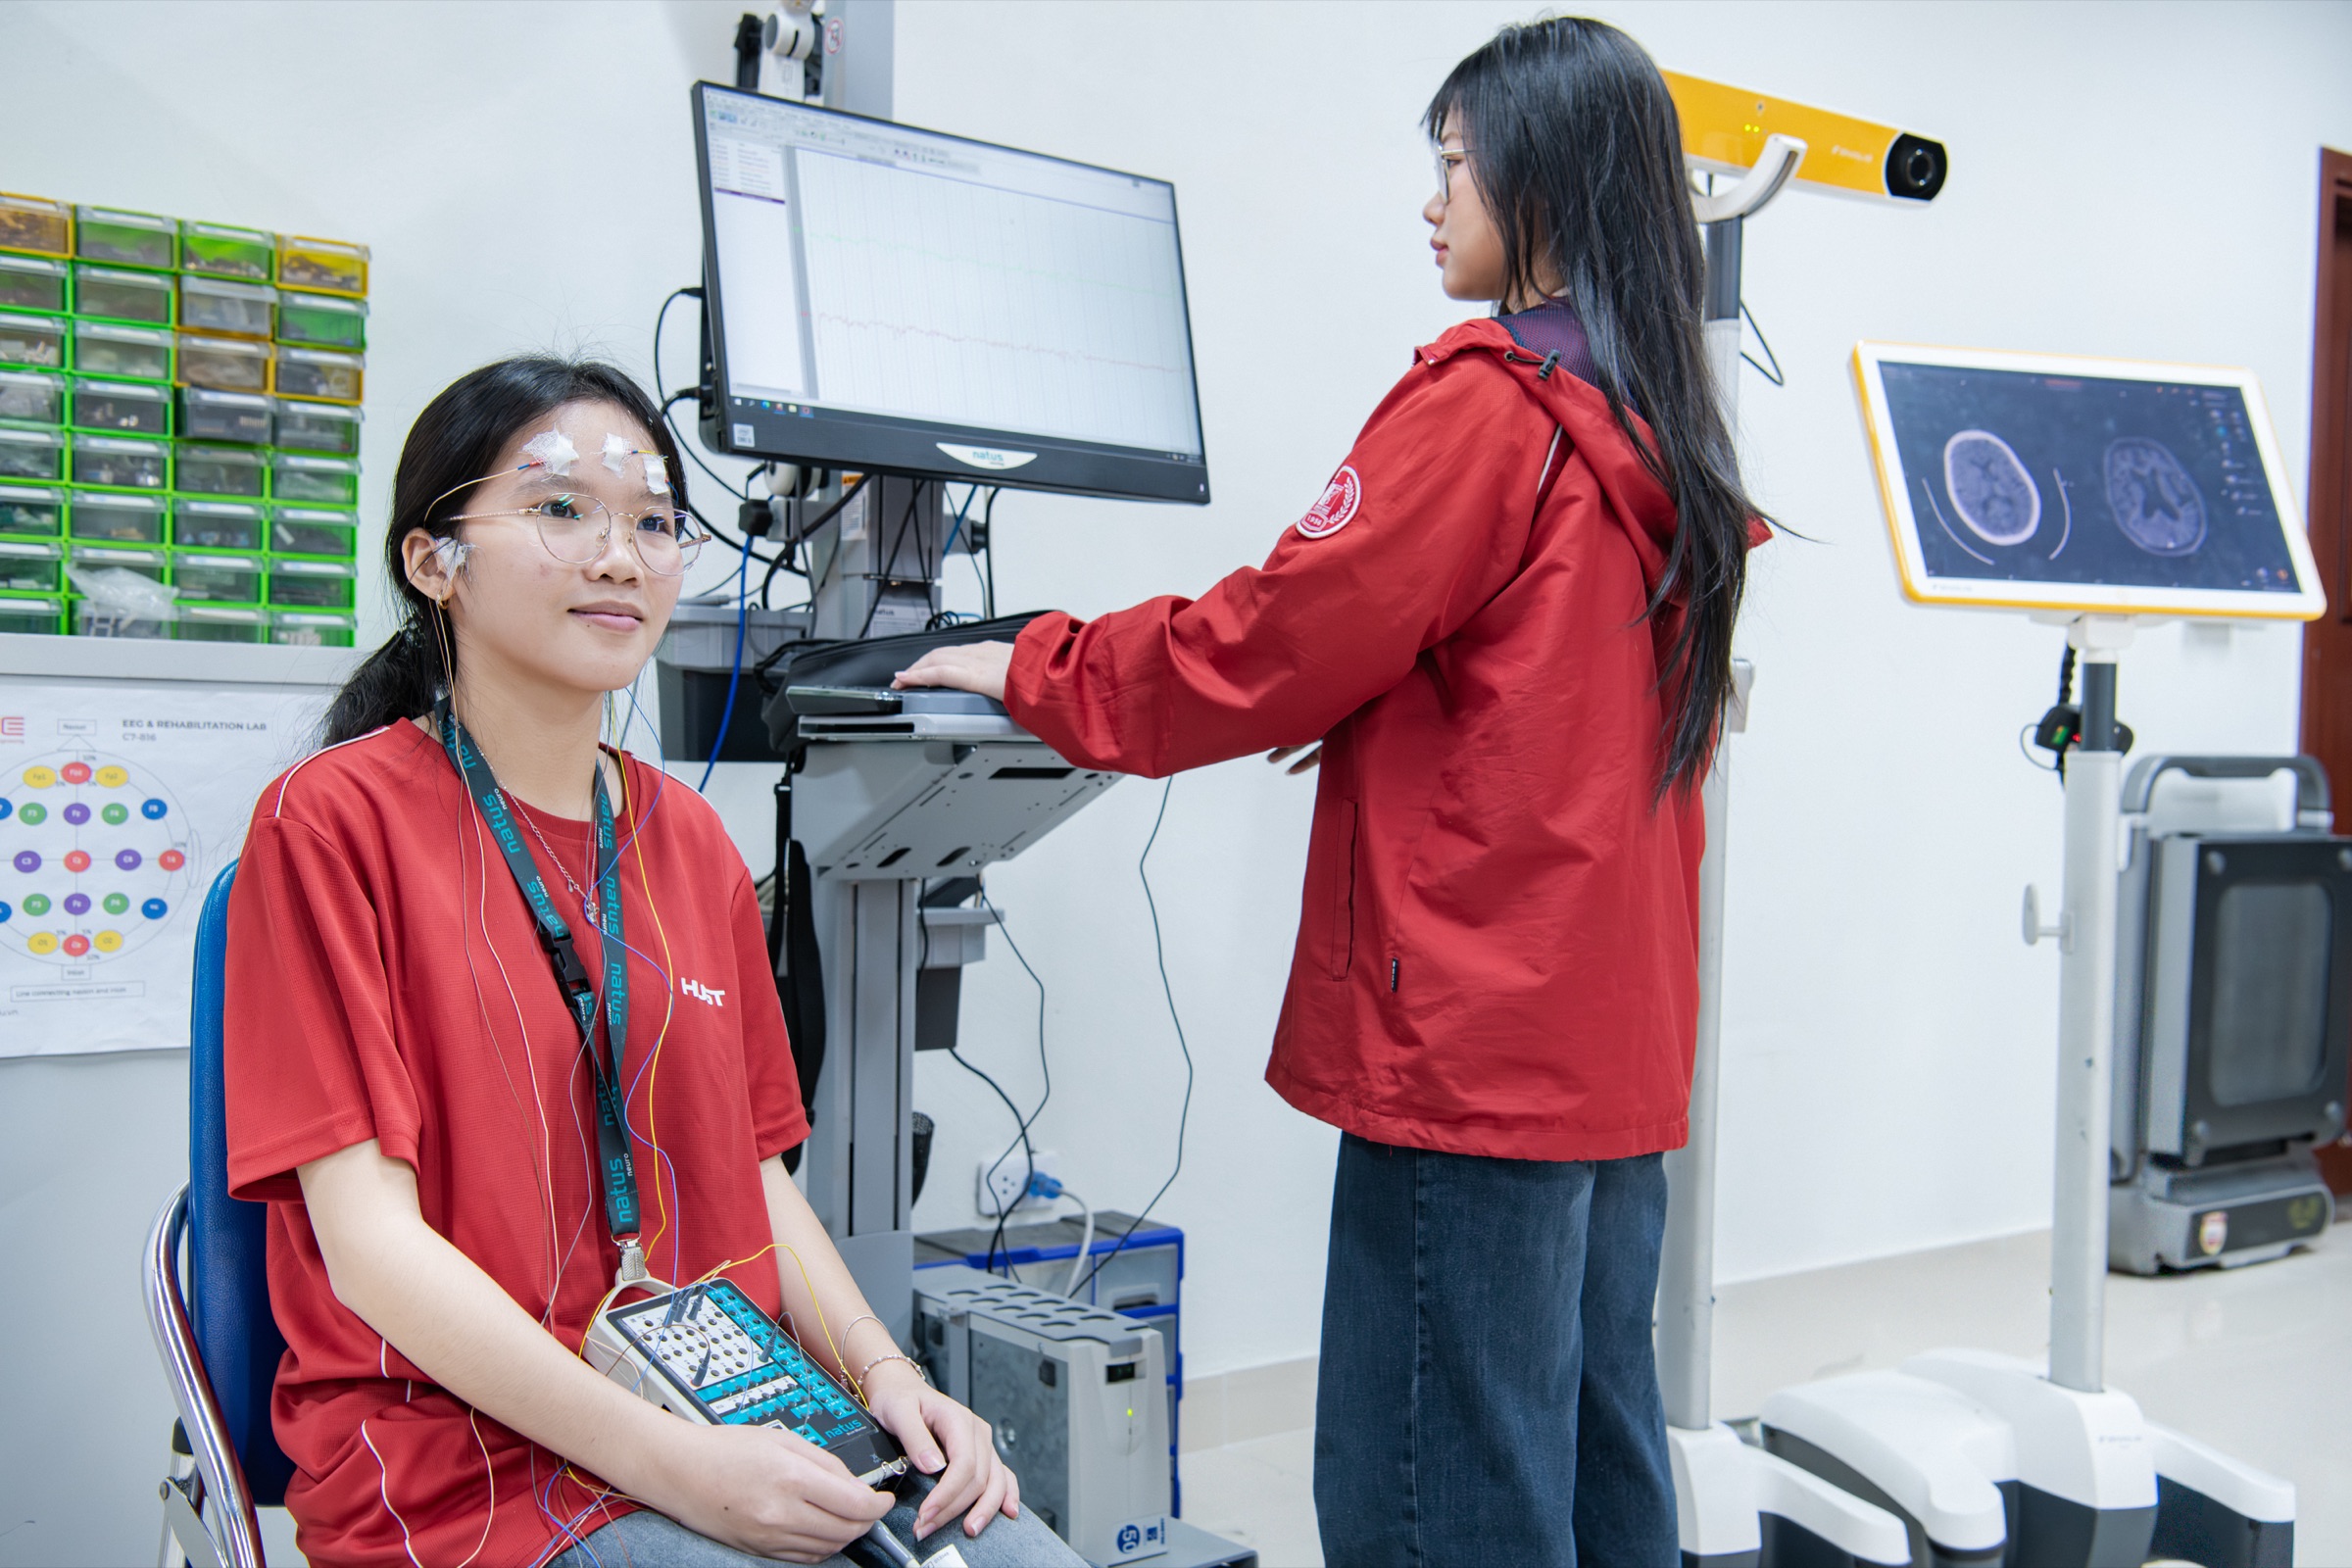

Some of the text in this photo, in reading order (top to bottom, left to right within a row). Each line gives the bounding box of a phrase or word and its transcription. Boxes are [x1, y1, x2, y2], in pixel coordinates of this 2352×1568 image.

[972, 450, 1004, 462] natus
[122, 719, 144, 728] EEG
[156, 720, 243, 730] REHABILITATION
[246, 722, 267, 731] LAB
[494, 788, 508, 810] neuro
[483, 794, 520, 854] natus
[599, 792, 613, 851] natus
[536, 875, 550, 898] neuro
[526, 880, 565, 938] natus
[606, 875, 620, 935] natus
[611, 962, 626, 1026] natus
[680, 976, 726, 1006] HUST
[623, 1152, 633, 1177] neuro
[610, 1157, 633, 1224] natus
[823, 1418, 863, 1440] natus
